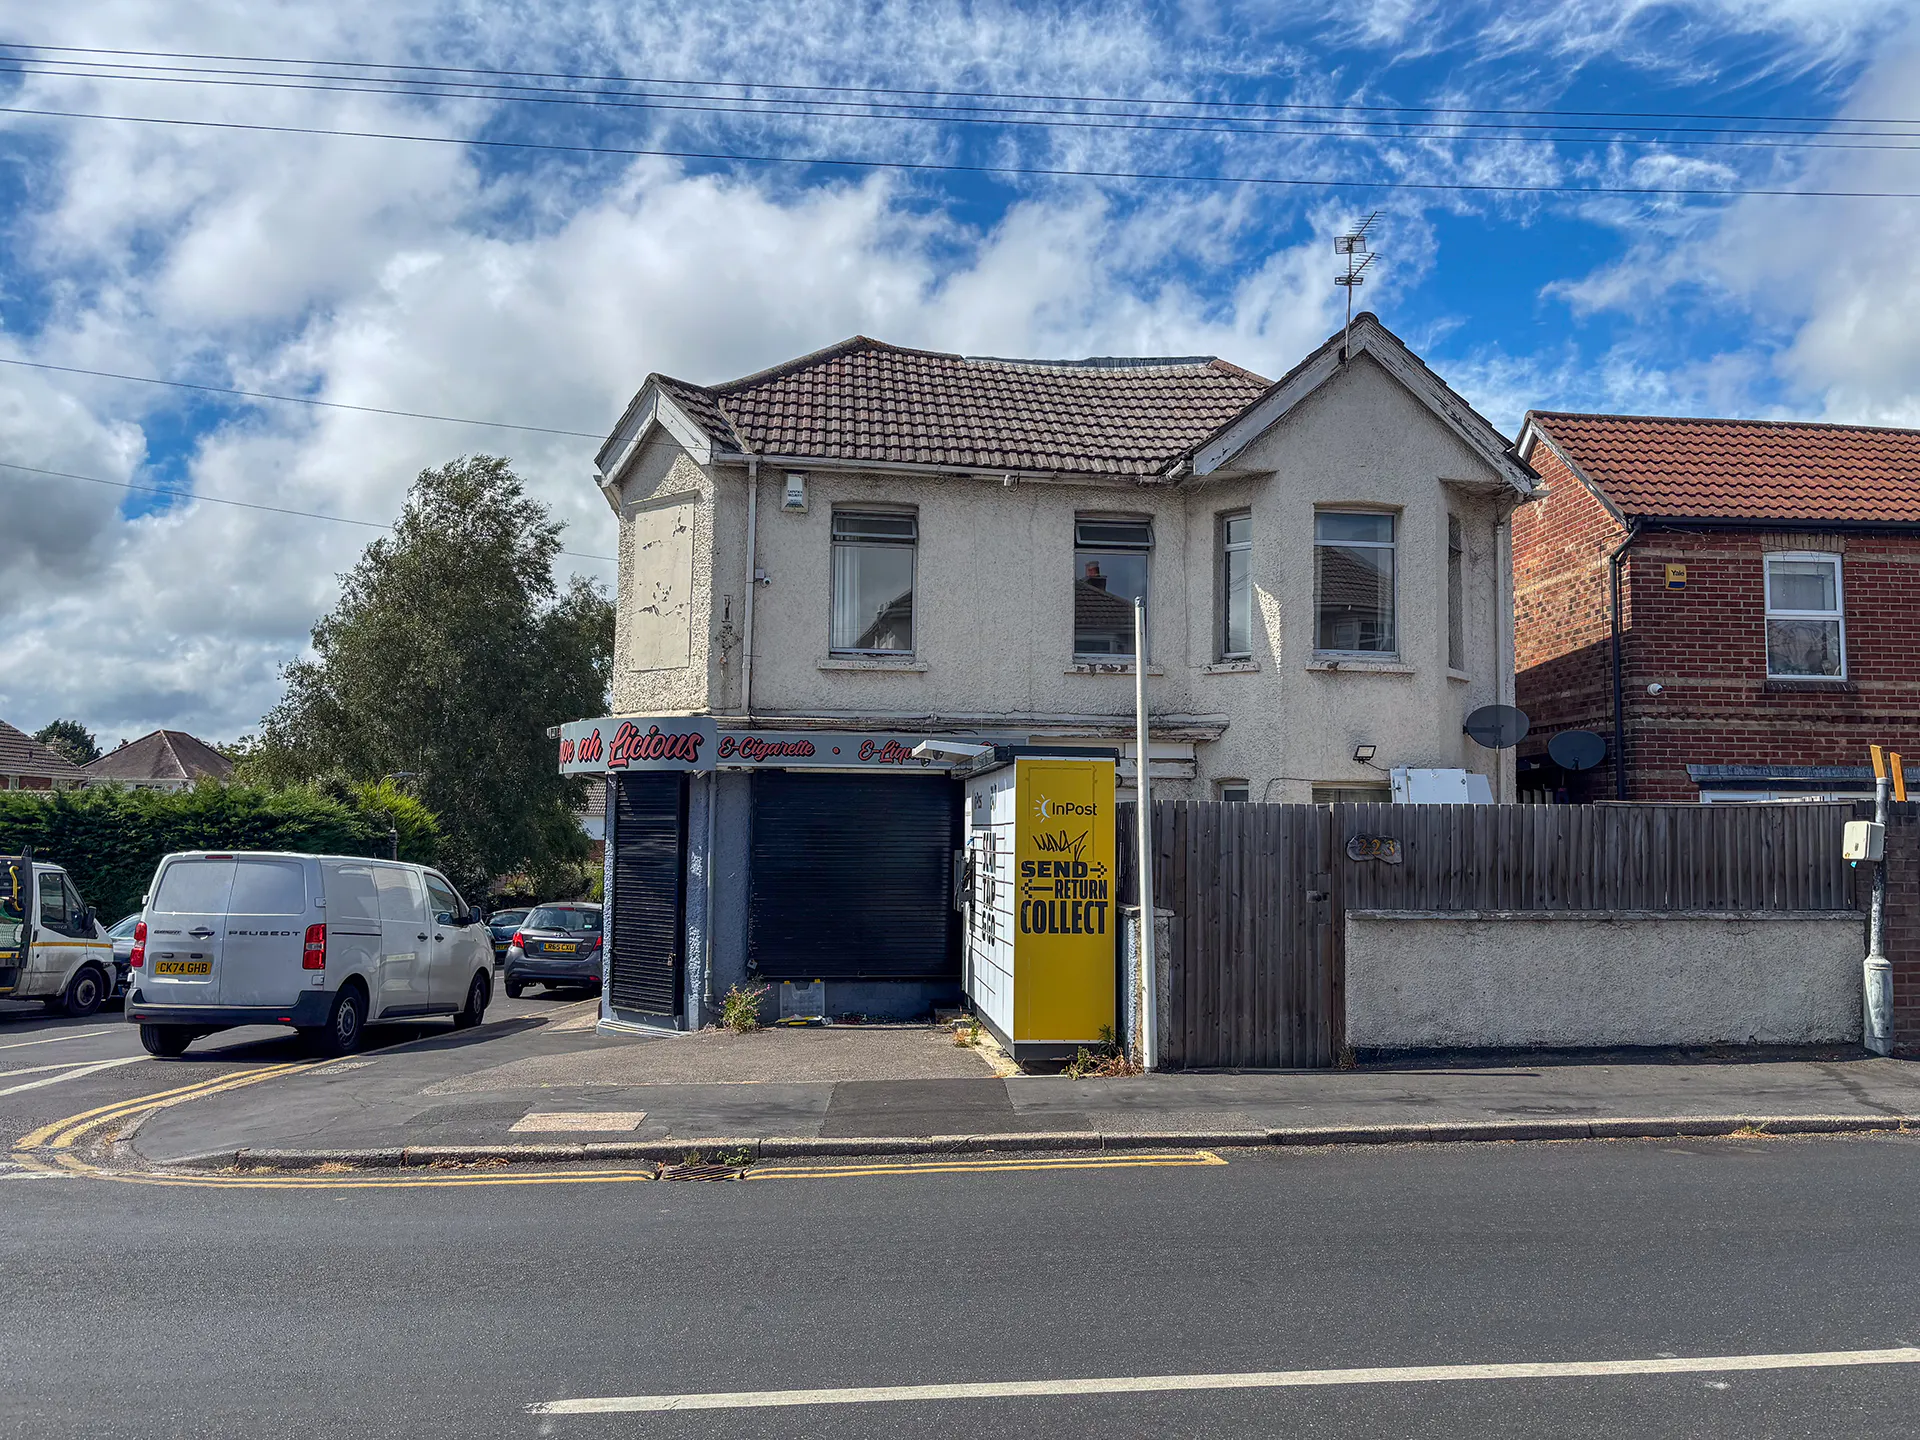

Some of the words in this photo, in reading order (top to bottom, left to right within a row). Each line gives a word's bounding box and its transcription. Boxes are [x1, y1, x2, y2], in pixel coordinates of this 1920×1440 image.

[1671, 569, 1685, 577] Yale
[578, 728, 603, 763] ah
[607, 721, 705, 769] Licious
[718, 736, 816, 762] E-Cigarette
[1052, 802, 1098, 816] InPost
[1359, 839, 1395, 857] 223
[1021, 861, 1088, 878] SEND
[1054, 879, 1108, 900] RETURN
[1020, 900, 1109, 934] COLLECT
[159, 962, 184, 973] CK74
[187, 962, 209, 974] GHB
